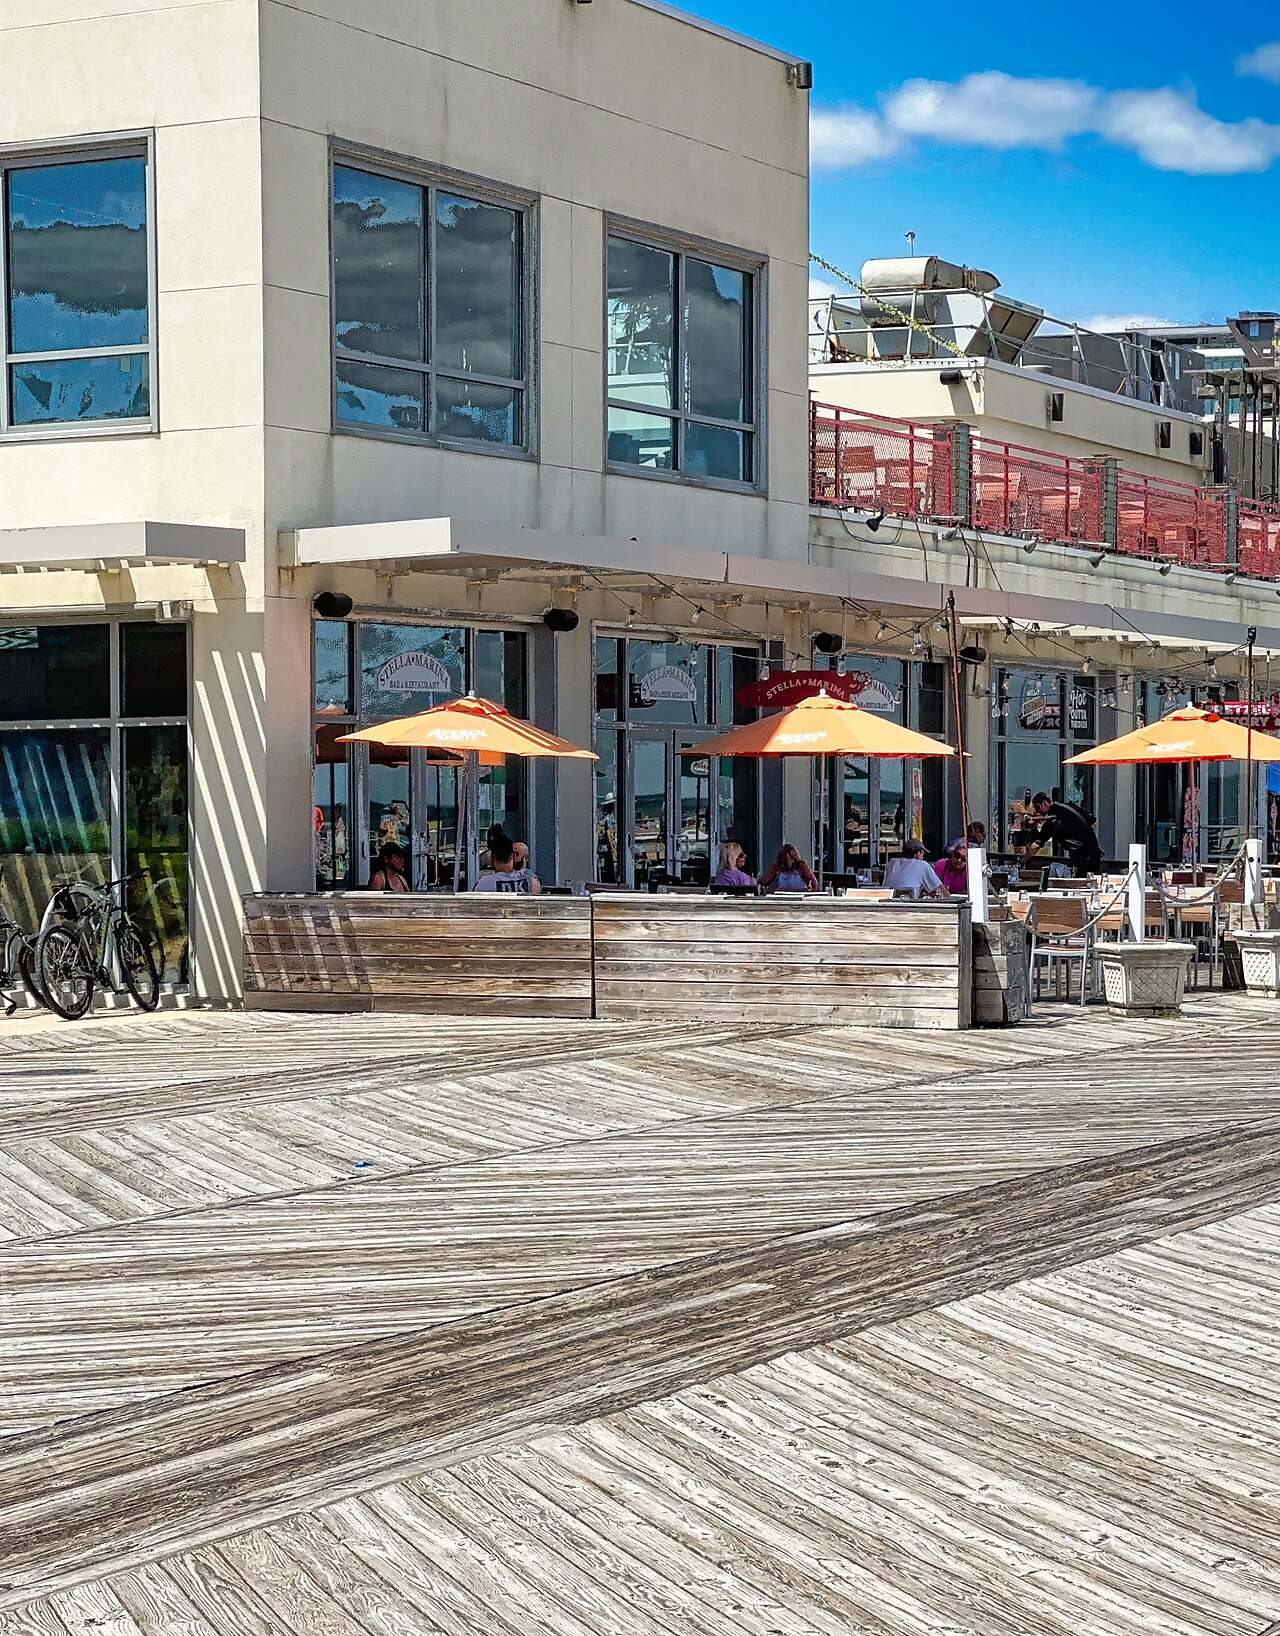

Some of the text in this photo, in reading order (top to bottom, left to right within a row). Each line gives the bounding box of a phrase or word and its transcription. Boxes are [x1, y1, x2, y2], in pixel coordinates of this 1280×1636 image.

[380, 654, 449, 689] STELLA MARINA
[766, 677, 846, 700] STELLA MARINA
[1070, 689, 1087, 709] Hot
